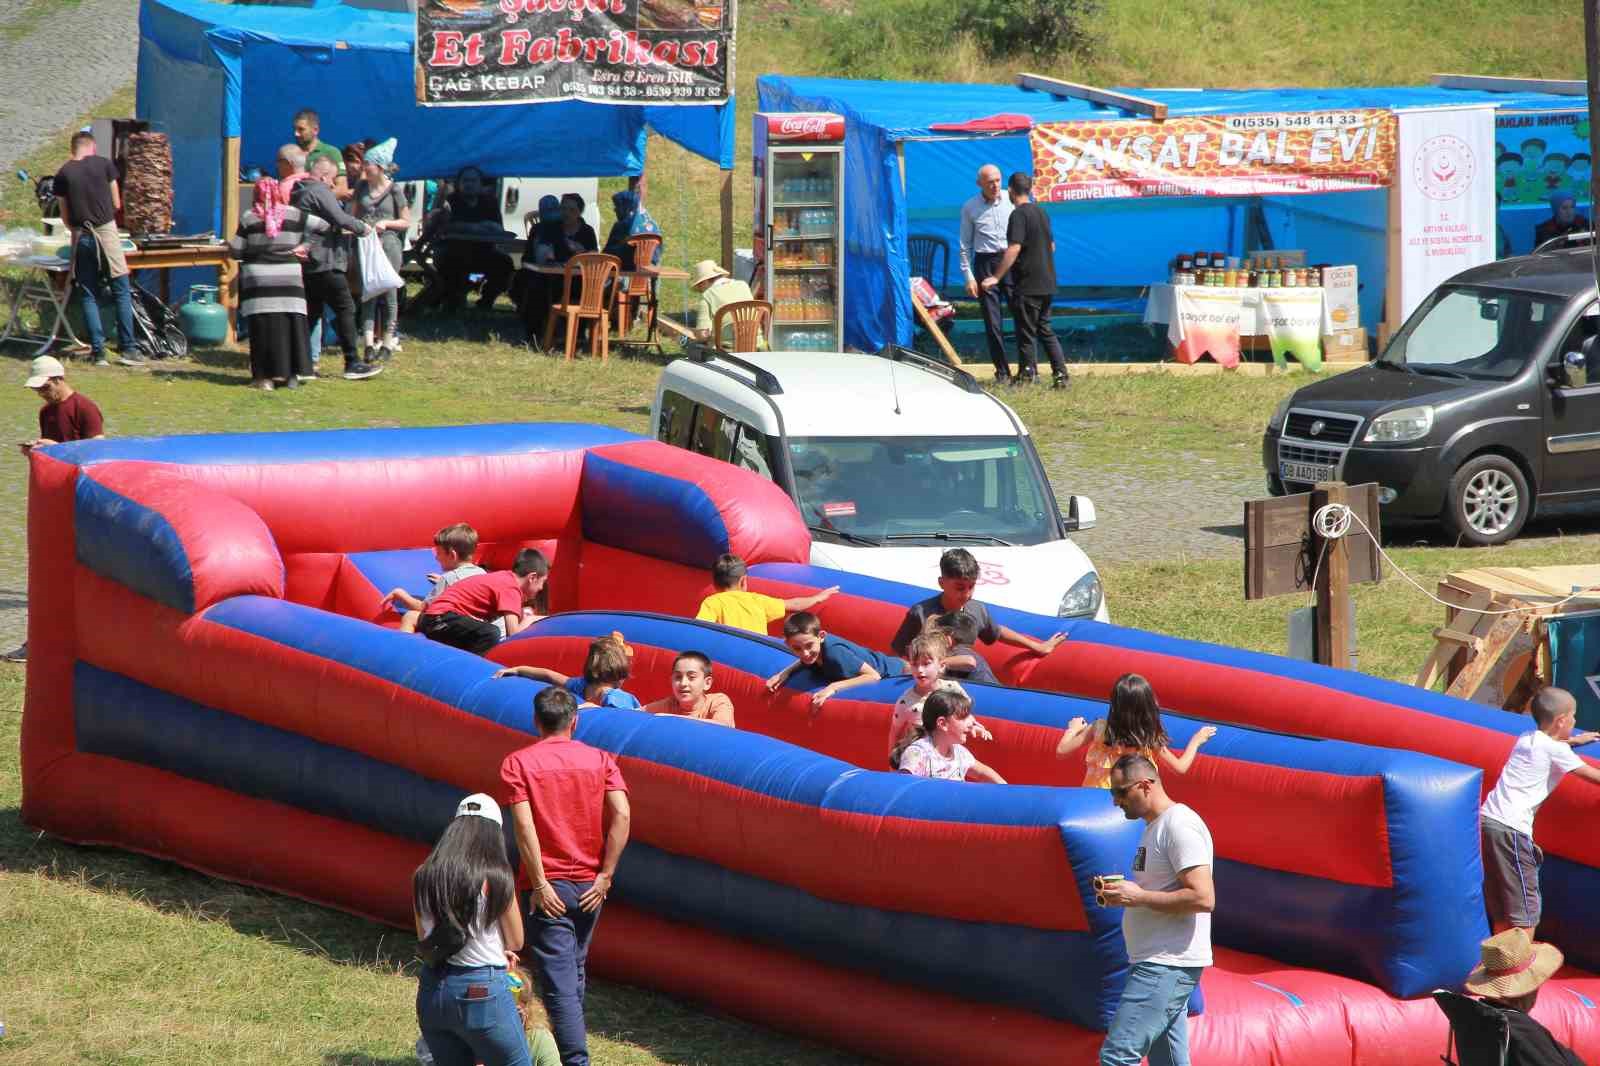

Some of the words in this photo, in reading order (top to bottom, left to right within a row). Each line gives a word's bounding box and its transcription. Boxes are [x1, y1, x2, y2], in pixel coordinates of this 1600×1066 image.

[429, 29, 485, 67] Et
[498, 27, 719, 66] Fabrikası
[429, 72, 472, 99] ÇAĞ
[481, 75, 545, 91] KEBAP
[623, 70, 635, 82] &
[1232, 116, 1280, 129] 0(535)
[1285, 115, 1311, 127] 548
[1316, 115, 1334, 126] 44
[1339, 114, 1357, 125] 33
[1219, 130, 1296, 167] BAL
[1310, 118, 1378, 165] EVİ
